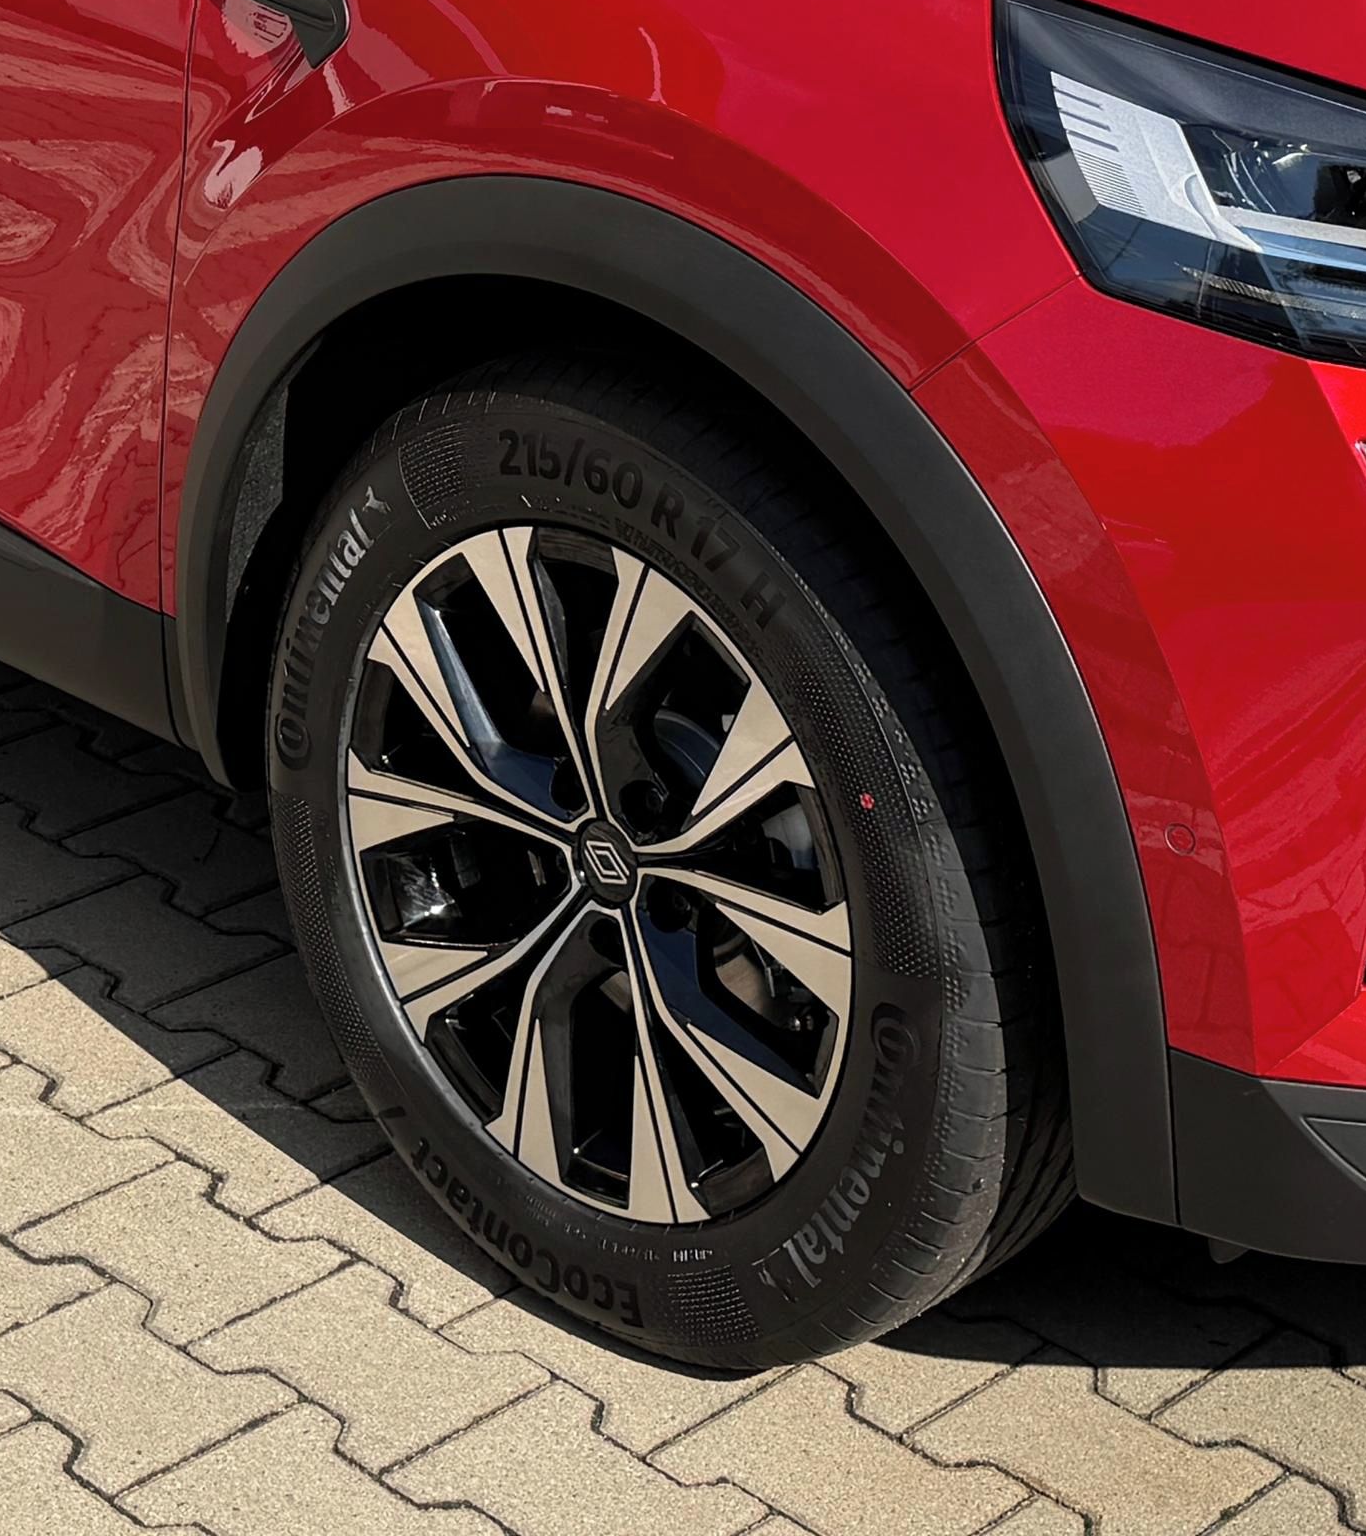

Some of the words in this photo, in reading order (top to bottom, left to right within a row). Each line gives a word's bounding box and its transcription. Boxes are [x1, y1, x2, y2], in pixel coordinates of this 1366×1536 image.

[274, 505, 375, 772] Continental
[497, 427, 644, 510] 215/60
[740, 568, 788, 631] H
[410, 1136, 644, 1330] EcoContact
[782, 1000, 922, 1290] Continental
